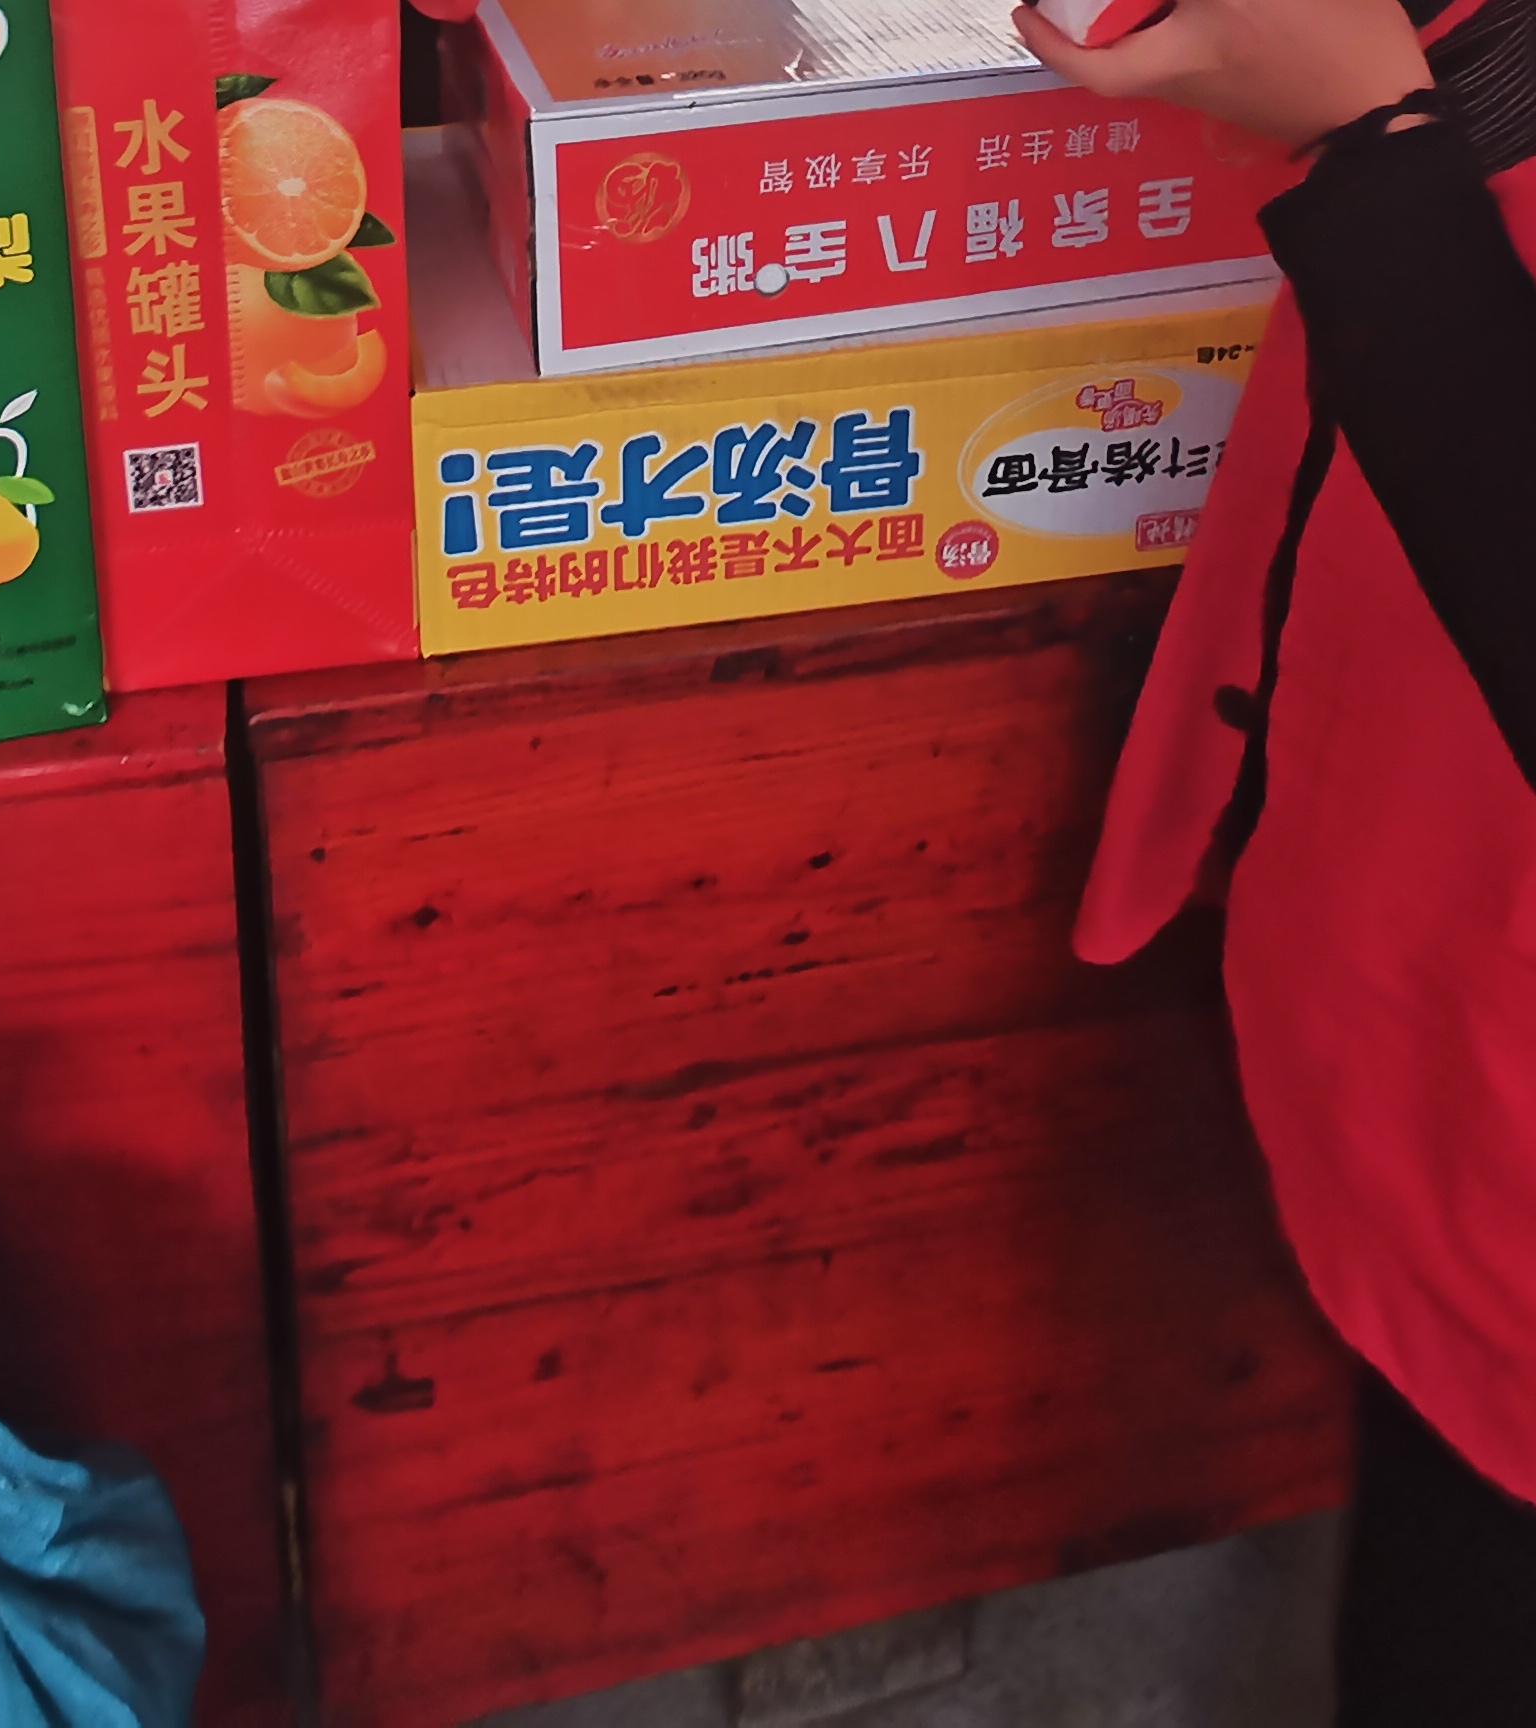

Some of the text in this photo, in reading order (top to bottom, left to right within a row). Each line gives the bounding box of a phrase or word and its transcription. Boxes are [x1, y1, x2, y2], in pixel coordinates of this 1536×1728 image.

[759, 118, 1141, 195] 健康生活 乐享极智
[112, 97, 209, 418] 水果罐头
[691, 176, 1195, 300] 全家福八宝粥
[439, 406, 923, 556] 骨汤才是!
[983, 435, 1227, 498] 汁猪骨面
[448, 512, 926, 610] 面大不是我们的特色
[942, 540, 991, 568] 骨汤
